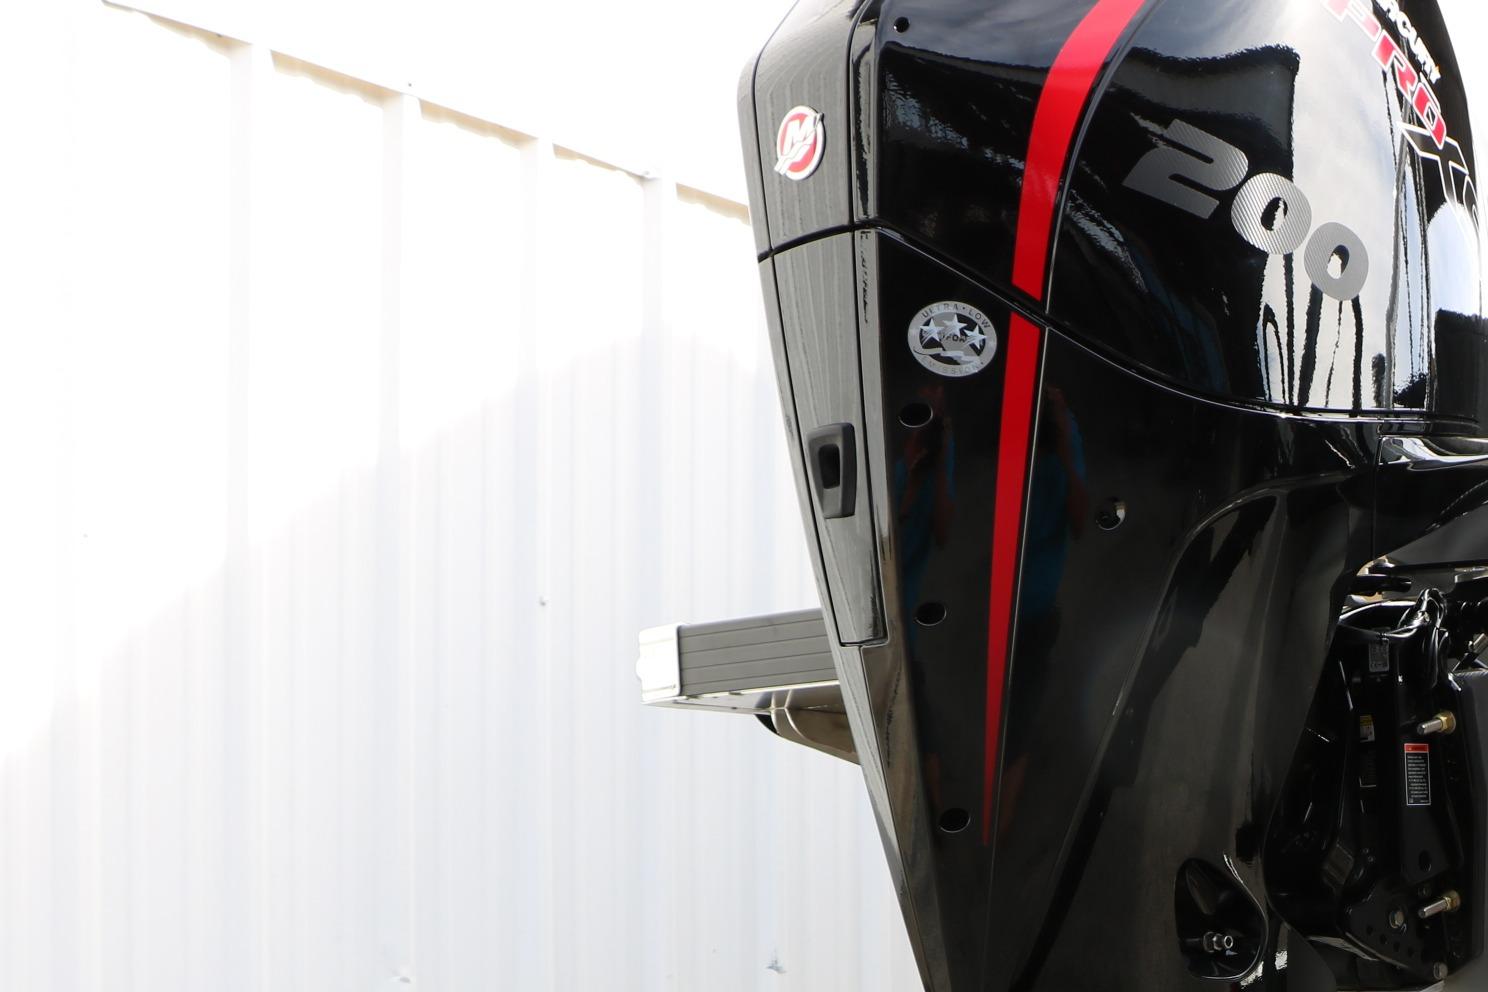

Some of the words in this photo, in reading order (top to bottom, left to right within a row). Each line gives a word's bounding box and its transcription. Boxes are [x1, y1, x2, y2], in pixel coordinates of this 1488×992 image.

[1376, 0, 1441, 84] RCURY
[1121, 118, 1369, 301] 200
[968, 308, 991, 328] LOW
